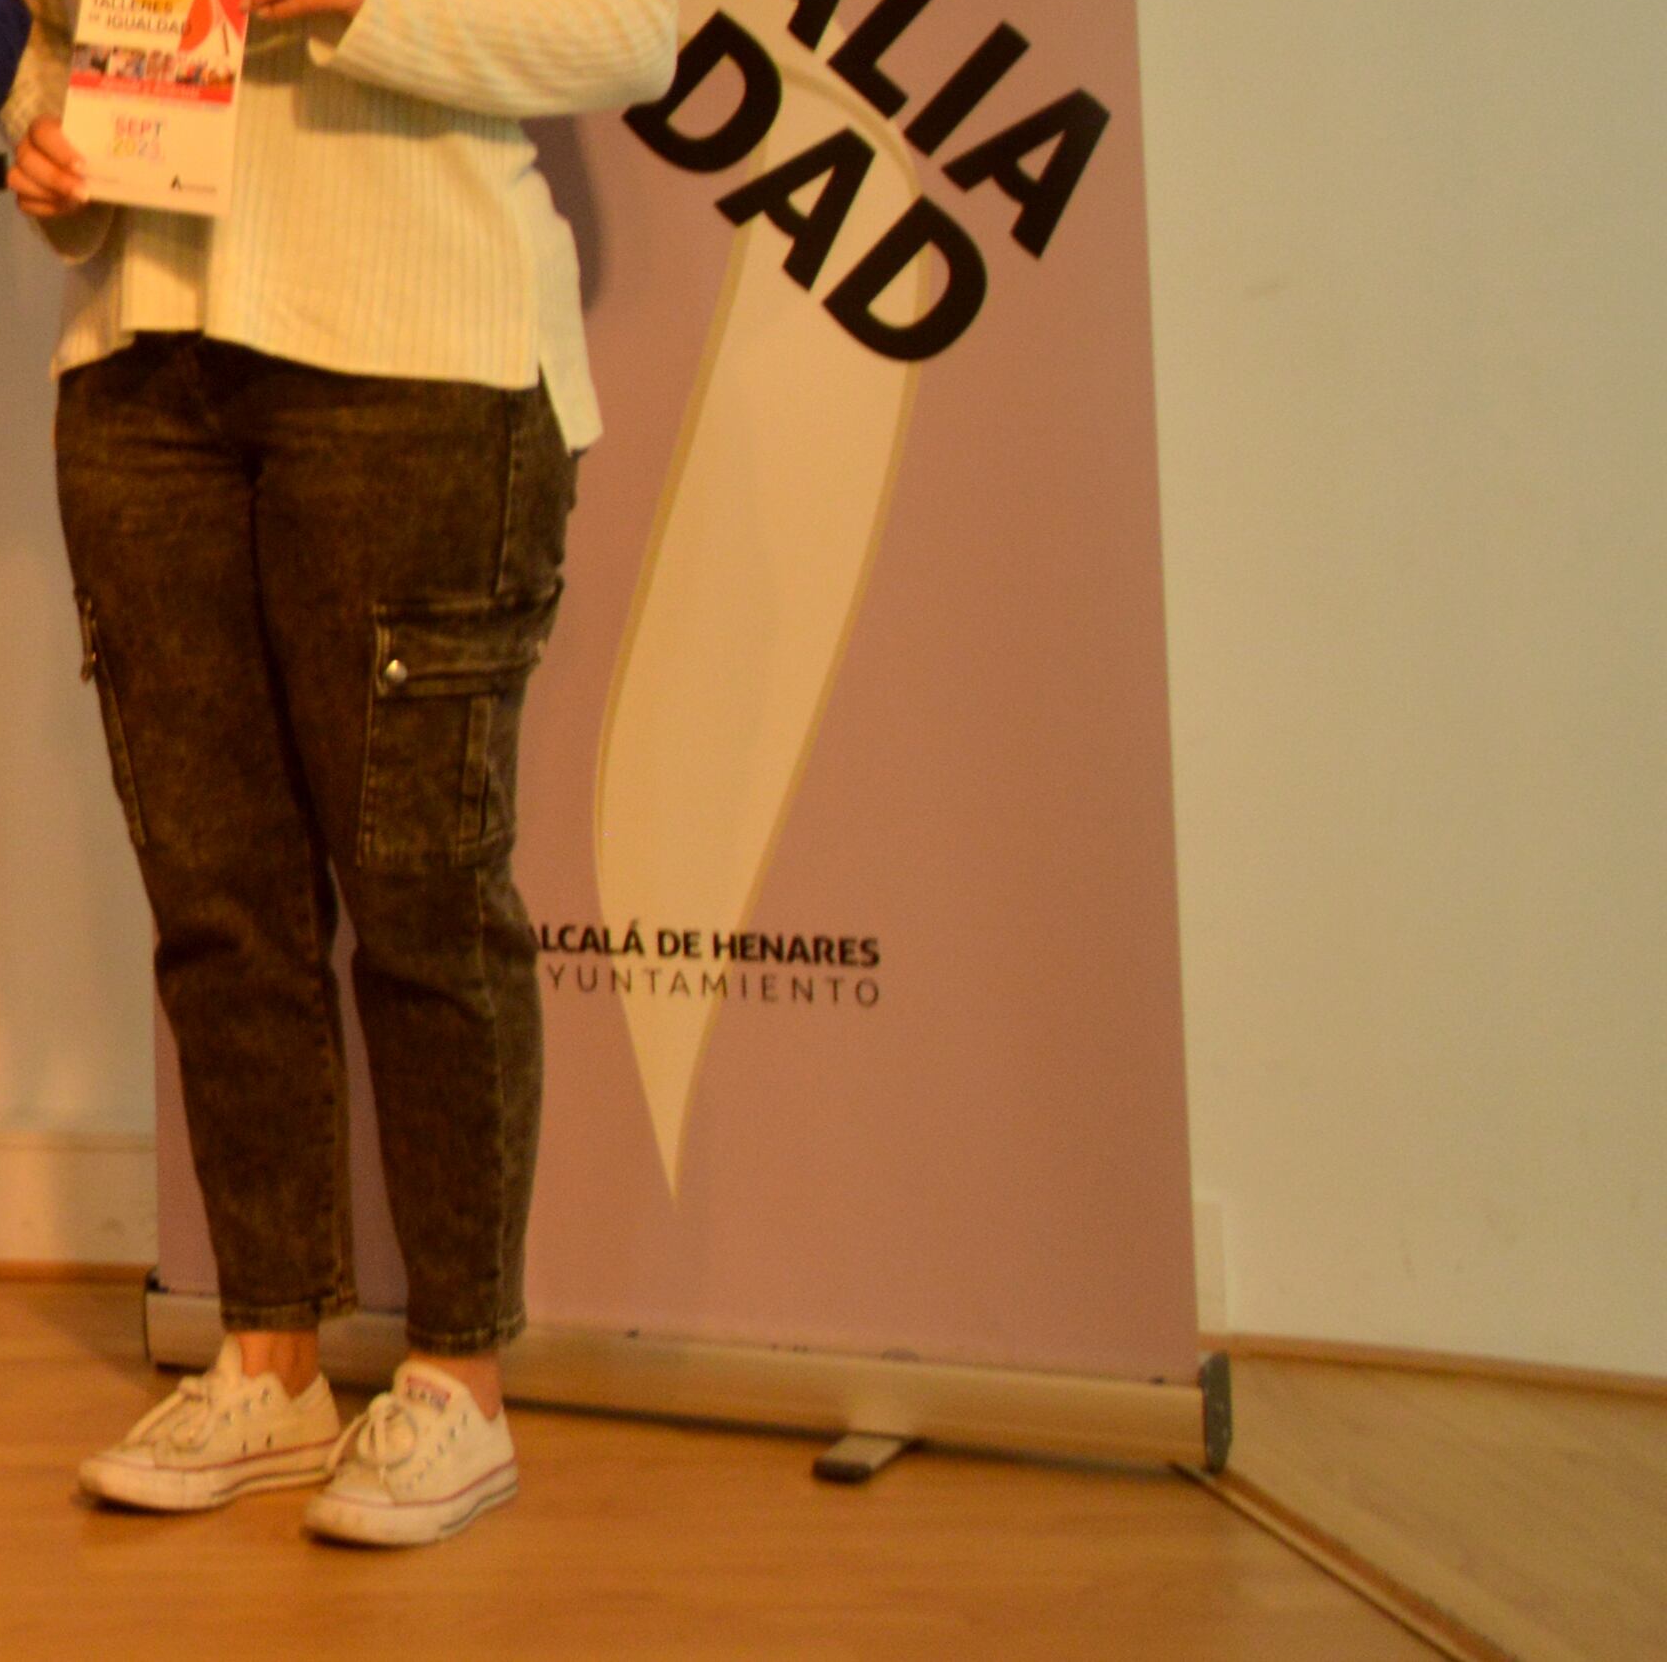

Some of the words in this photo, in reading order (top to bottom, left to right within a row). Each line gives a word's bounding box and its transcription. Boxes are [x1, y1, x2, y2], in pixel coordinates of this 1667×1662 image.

[622, 10, 988, 362] DAD
[657, 930, 702, 958] DE
[713, 933, 880, 968] HENARES
[546, 963, 880, 1008] YUNTAMIENTO
